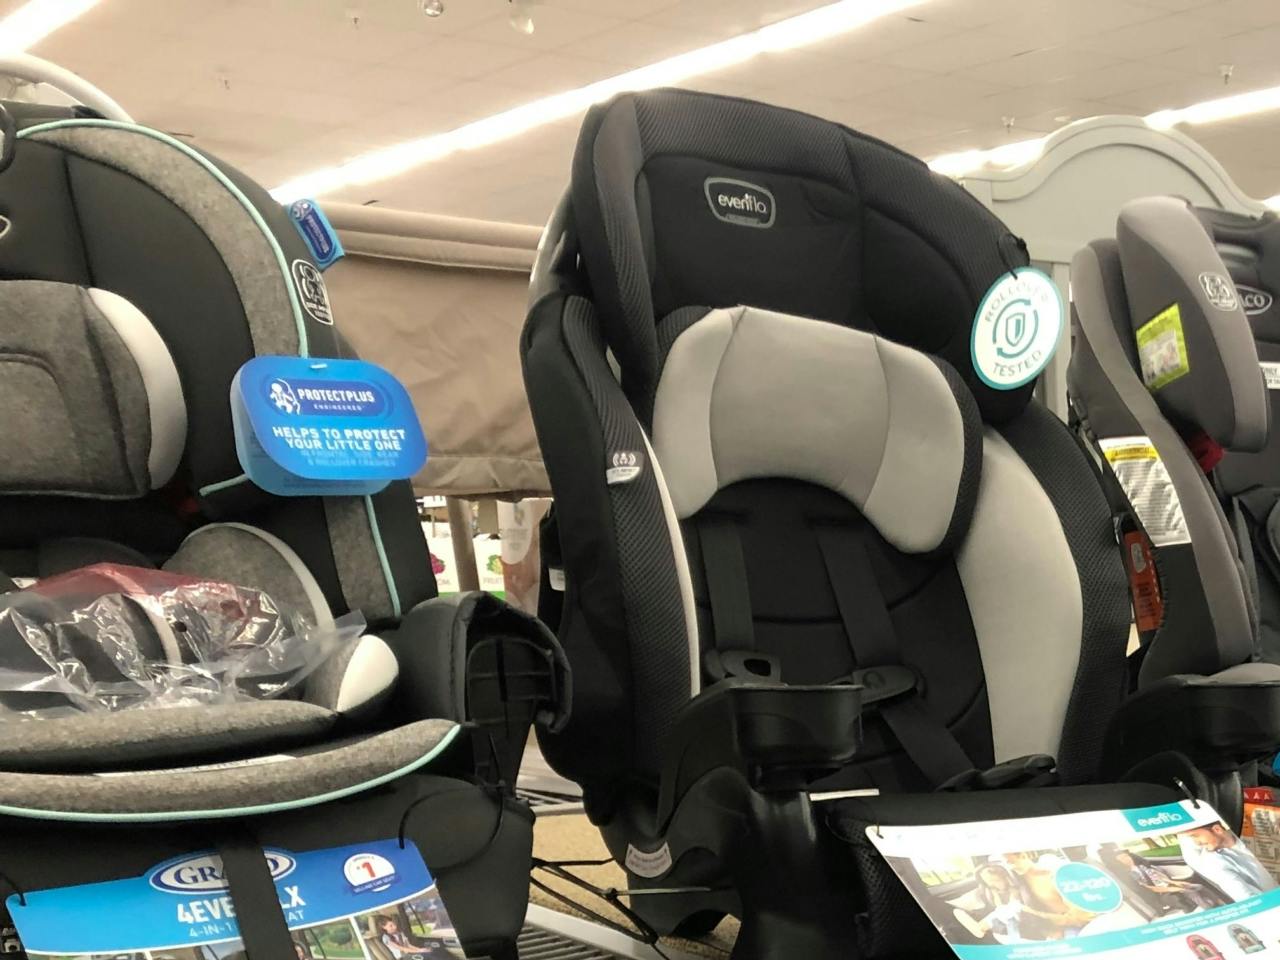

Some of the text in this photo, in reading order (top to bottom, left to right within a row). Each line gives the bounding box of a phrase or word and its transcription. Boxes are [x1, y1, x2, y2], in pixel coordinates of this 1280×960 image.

[717, 193, 768, 215] evenflo
[993, 349, 1043, 378] TESTED
[297, 388, 376, 403] PROTECTPLUS
[272, 426, 406, 441] HELPS TO PROTECT
[285, 437, 402, 451] YOUR LITTLE ONE
[189, 922, 233, 937] 4-IN-1
